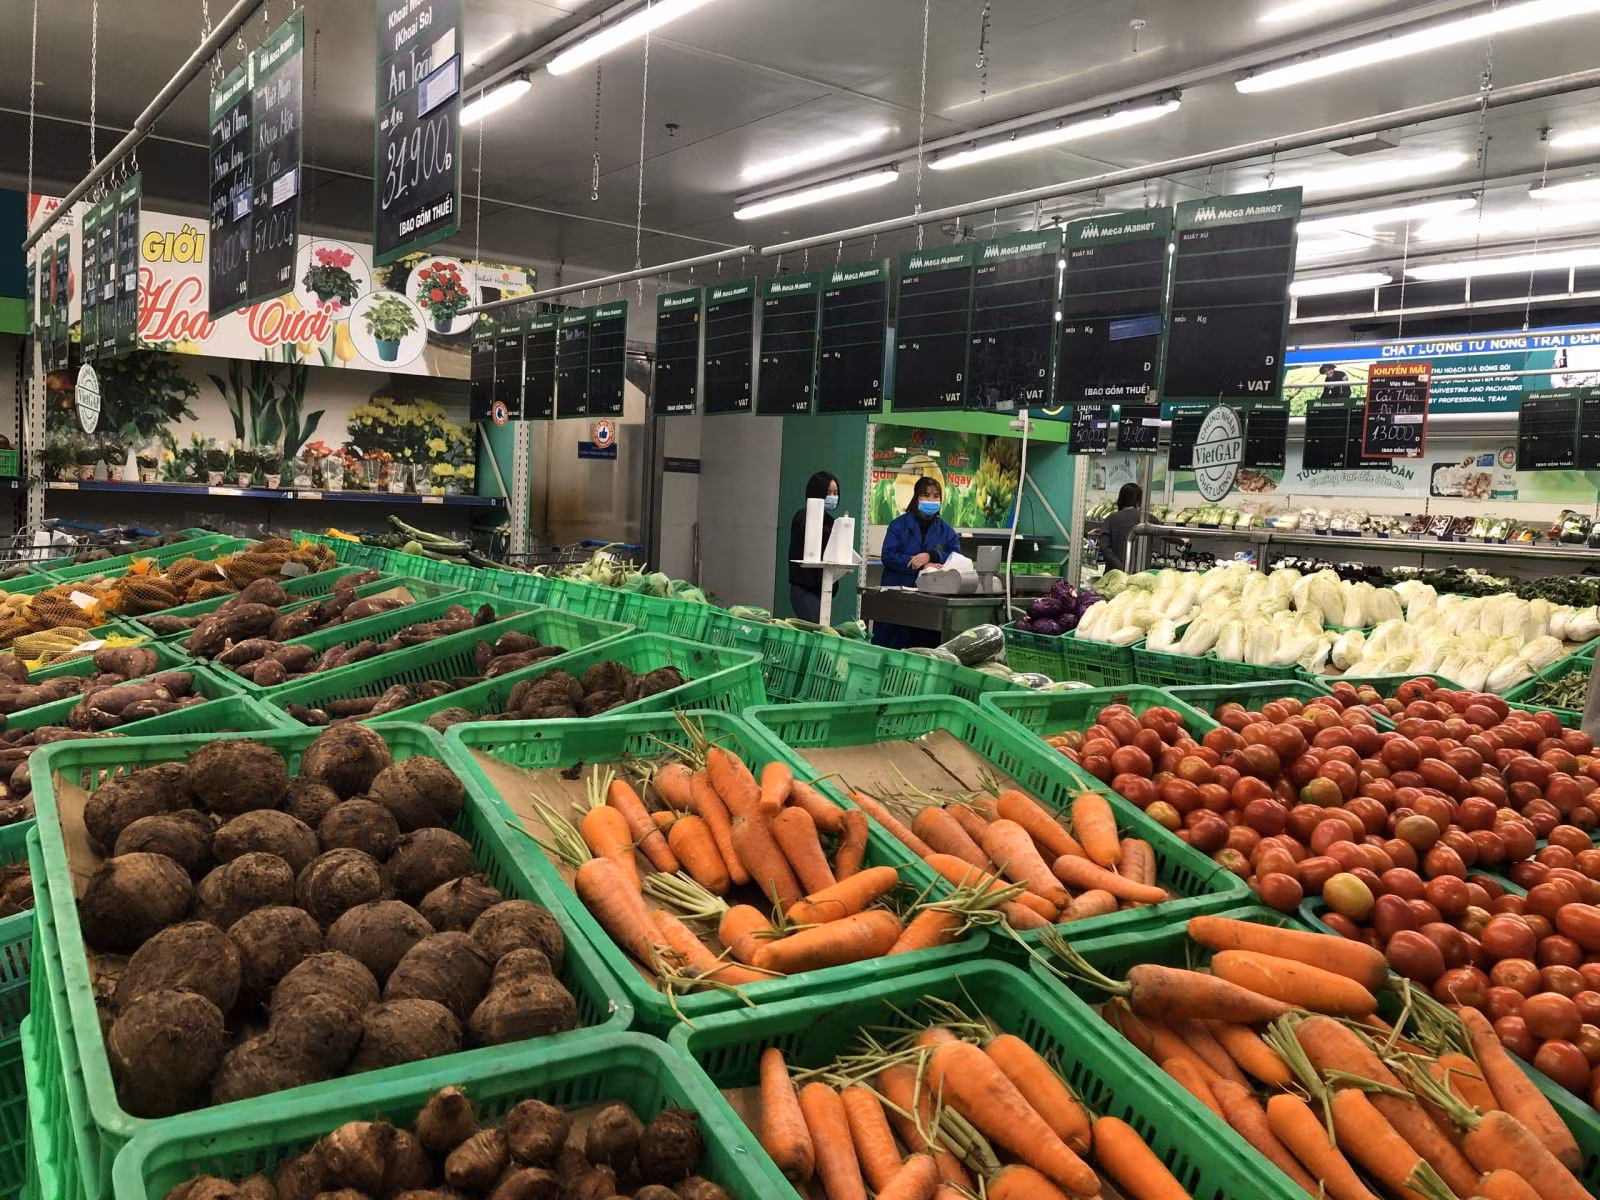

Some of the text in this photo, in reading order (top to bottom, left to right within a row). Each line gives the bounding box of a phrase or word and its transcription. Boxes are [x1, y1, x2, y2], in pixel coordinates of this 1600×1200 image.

[388, 2, 408, 31] Khoai
[388, 63, 406, 101] An
[1217, 204, 1283, 219] Mega Market
[1100, 222, 1156, 237] Mega Market
[142, 223, 205, 263] GIỚI
[1000, 241, 1047, 256] Mega Market
[923, 254, 964, 268] Mega Market
[280, 265, 291, 282] VAT
[844, 269, 880, 281] Mega Market
[239, 280, 247, 295] VA
[782, 282, 812, 292] Mega Market
[1197, 315, 1207, 323] Kg
[1084, 326, 1094, 334] Kg
[1265, 355, 1274, 366] Đ
[1143, 362, 1151, 371] Đ
[1247, 380, 1271, 391] VAT
[1485, 384, 1523, 392] PACKAGING
[945, 392, 961, 402] VAT
[1026, 389, 1044, 400] VAT
[1084, 387, 1103, 396] (BAO
[738, 398, 748, 407] VAT
[863, 398, 877, 407] VAT
[1438, 396, 1485, 404] PROFESSIONAL
[796, 402, 808, 410] VAT
[1195, 441, 1240, 465] VietGAP
